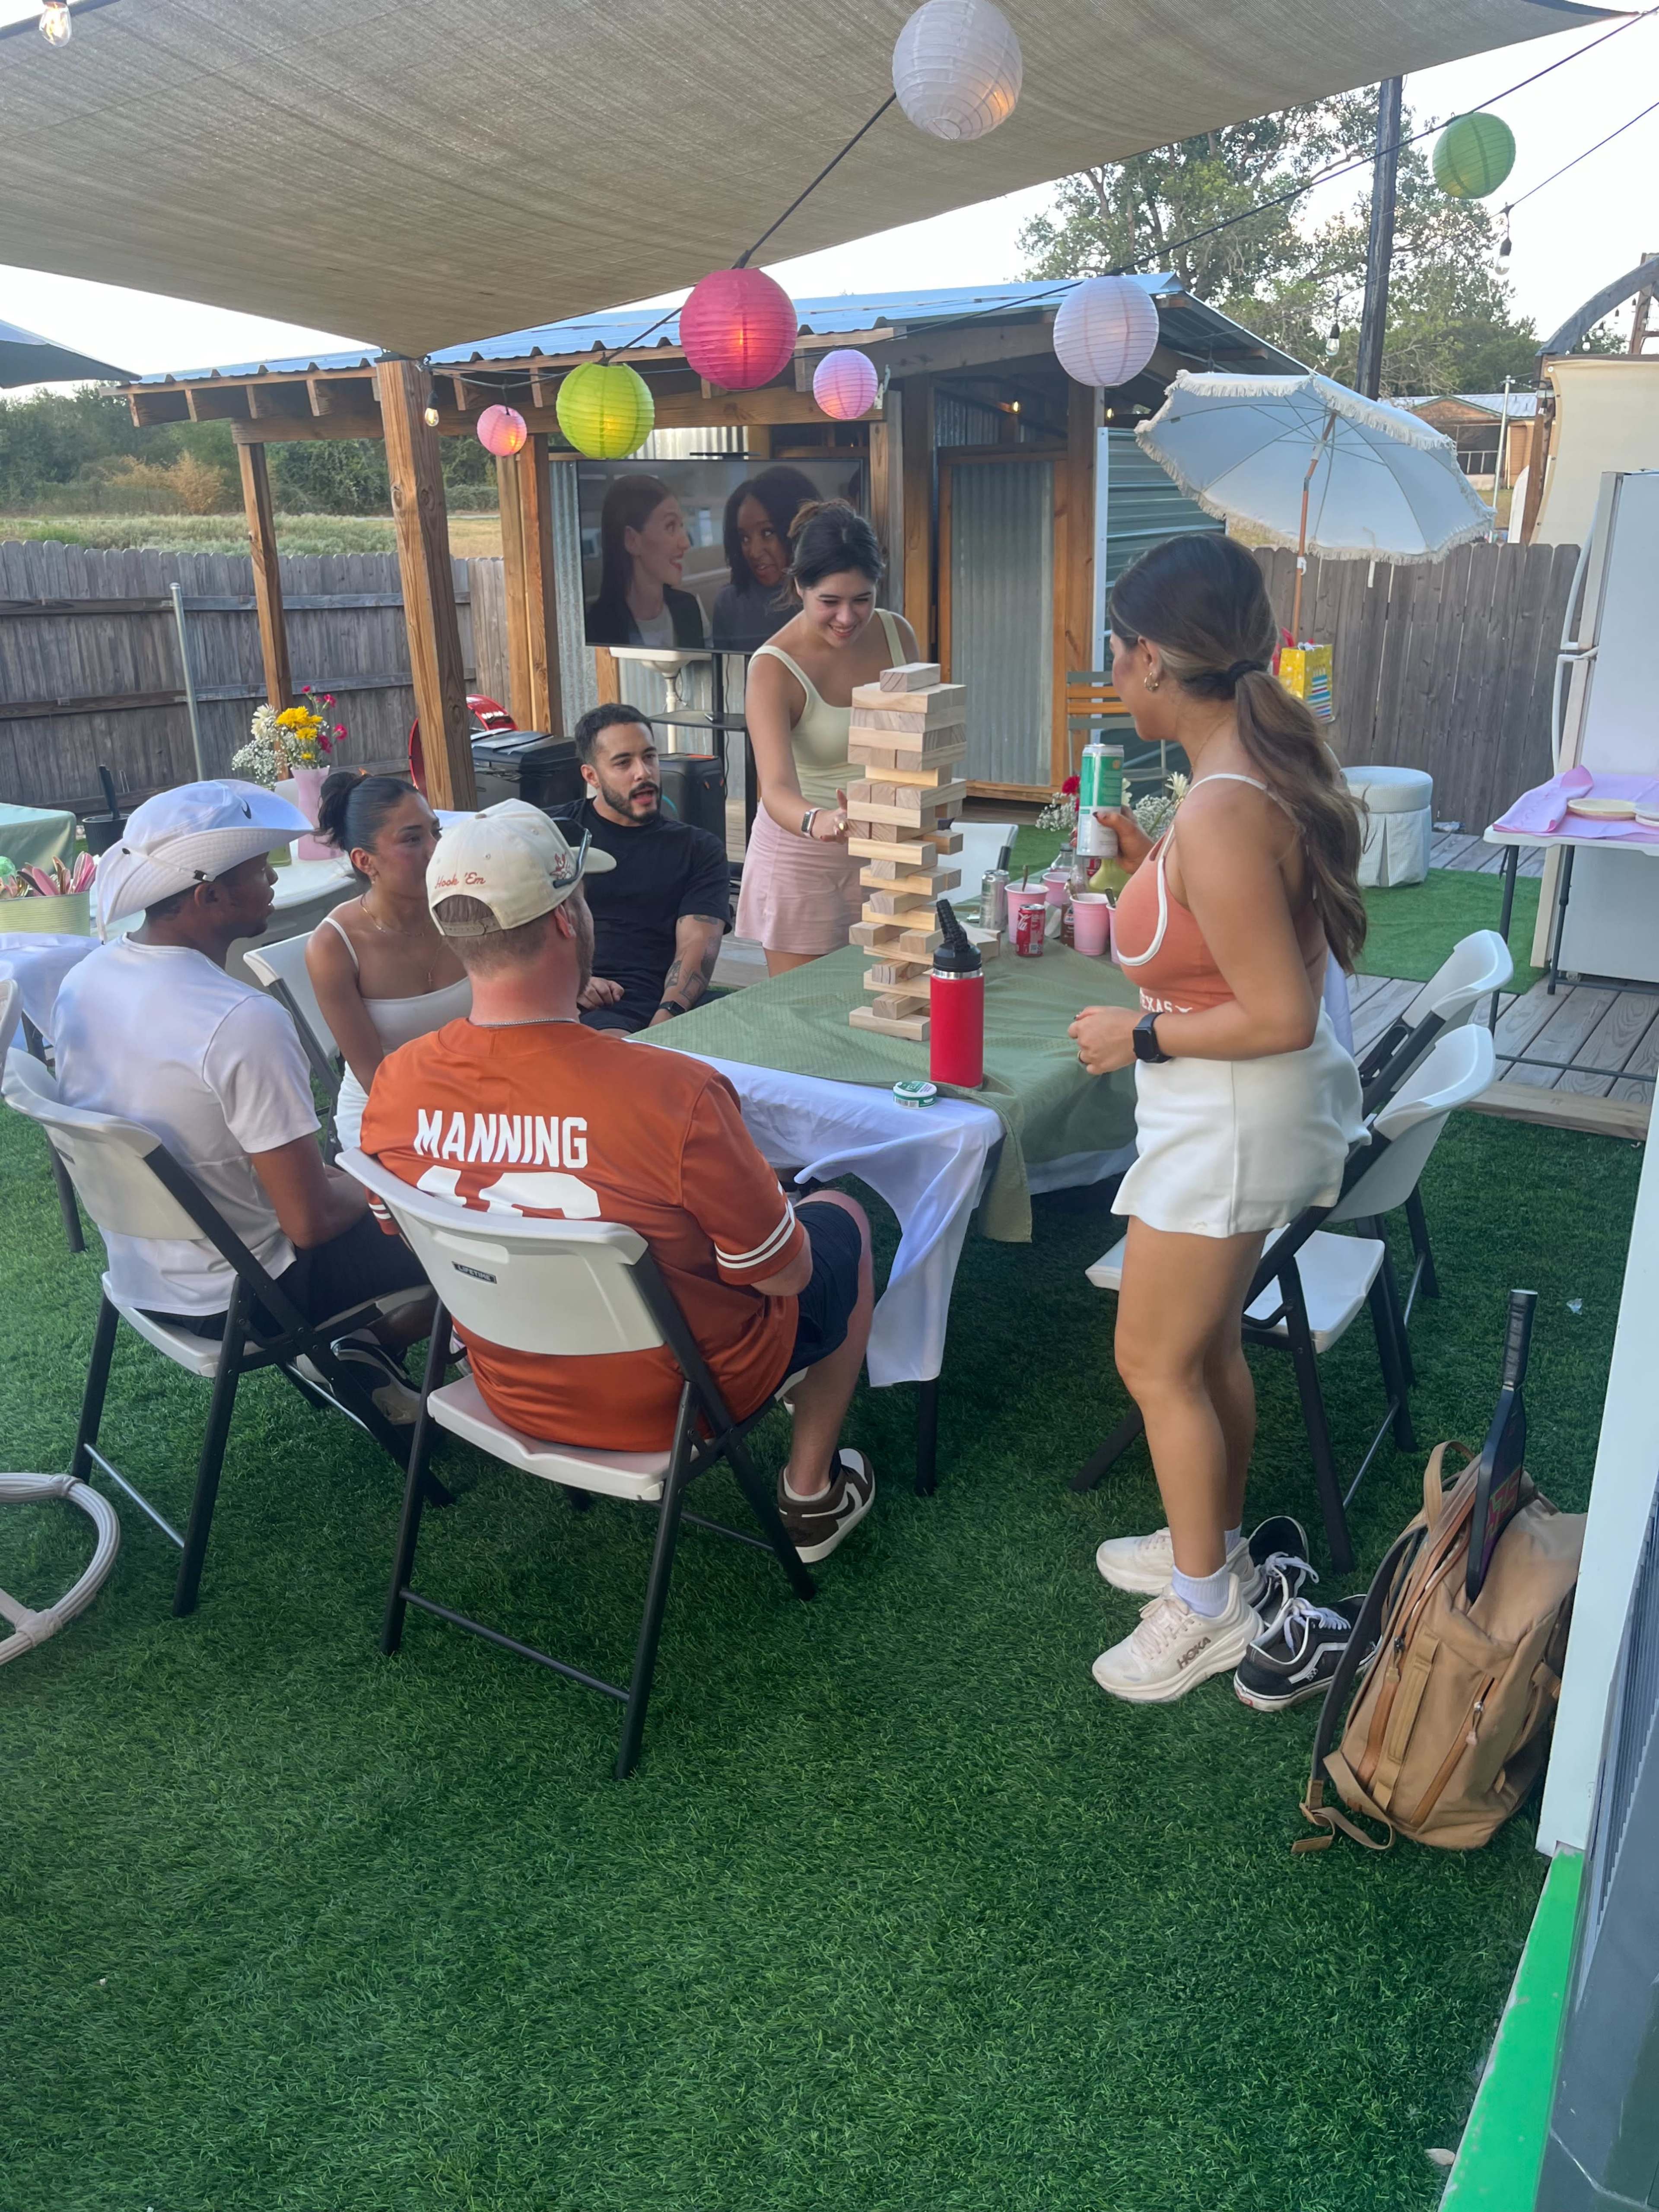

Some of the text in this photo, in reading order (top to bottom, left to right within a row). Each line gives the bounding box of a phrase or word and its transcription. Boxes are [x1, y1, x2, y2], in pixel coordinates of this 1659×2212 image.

[435, 871, 486, 889] Hook 'Em
[413, 1109, 588, 1168] MANNING
[458, 1265, 492, 1281] LIFETIME
[1177, 1637, 1211, 1669] HOKA
